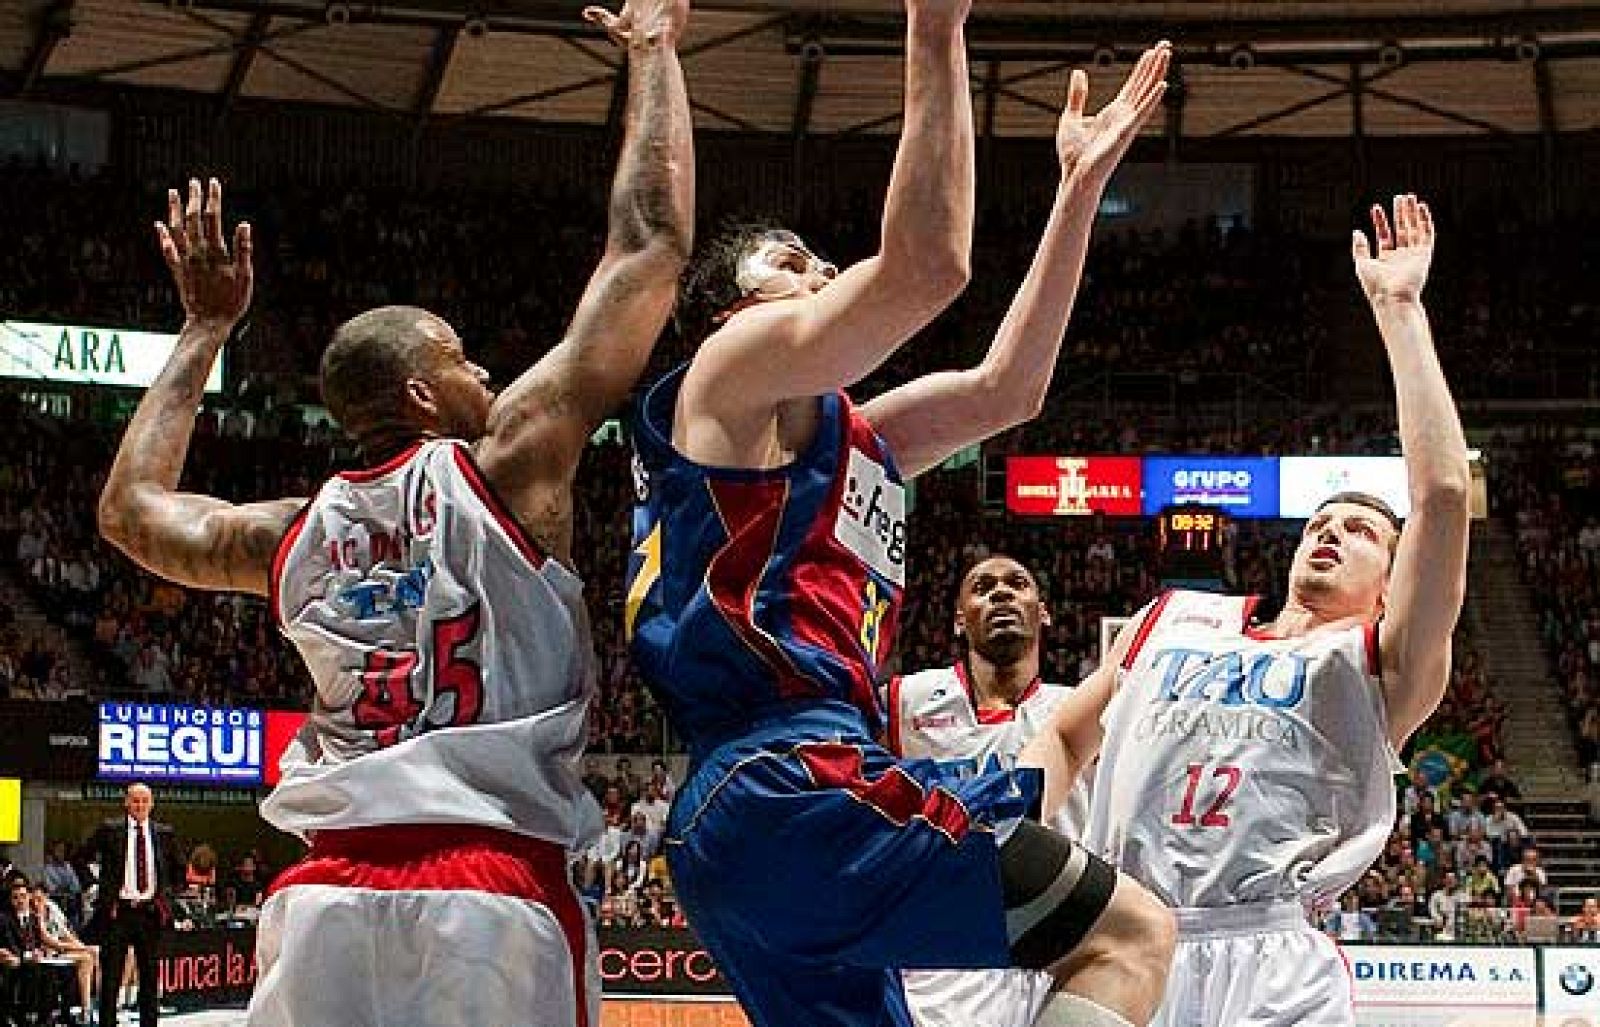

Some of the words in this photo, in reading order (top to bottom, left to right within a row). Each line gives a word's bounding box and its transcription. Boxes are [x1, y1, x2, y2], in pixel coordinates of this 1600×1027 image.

[54, 328, 126, 373] ARA
[353, 603, 484, 746] 45
[1152, 649, 1314, 708] TAU
[99, 724, 260, 765] REGUI
[1171, 764, 1242, 827] 12
[1354, 962, 1477, 982] DIREMA
